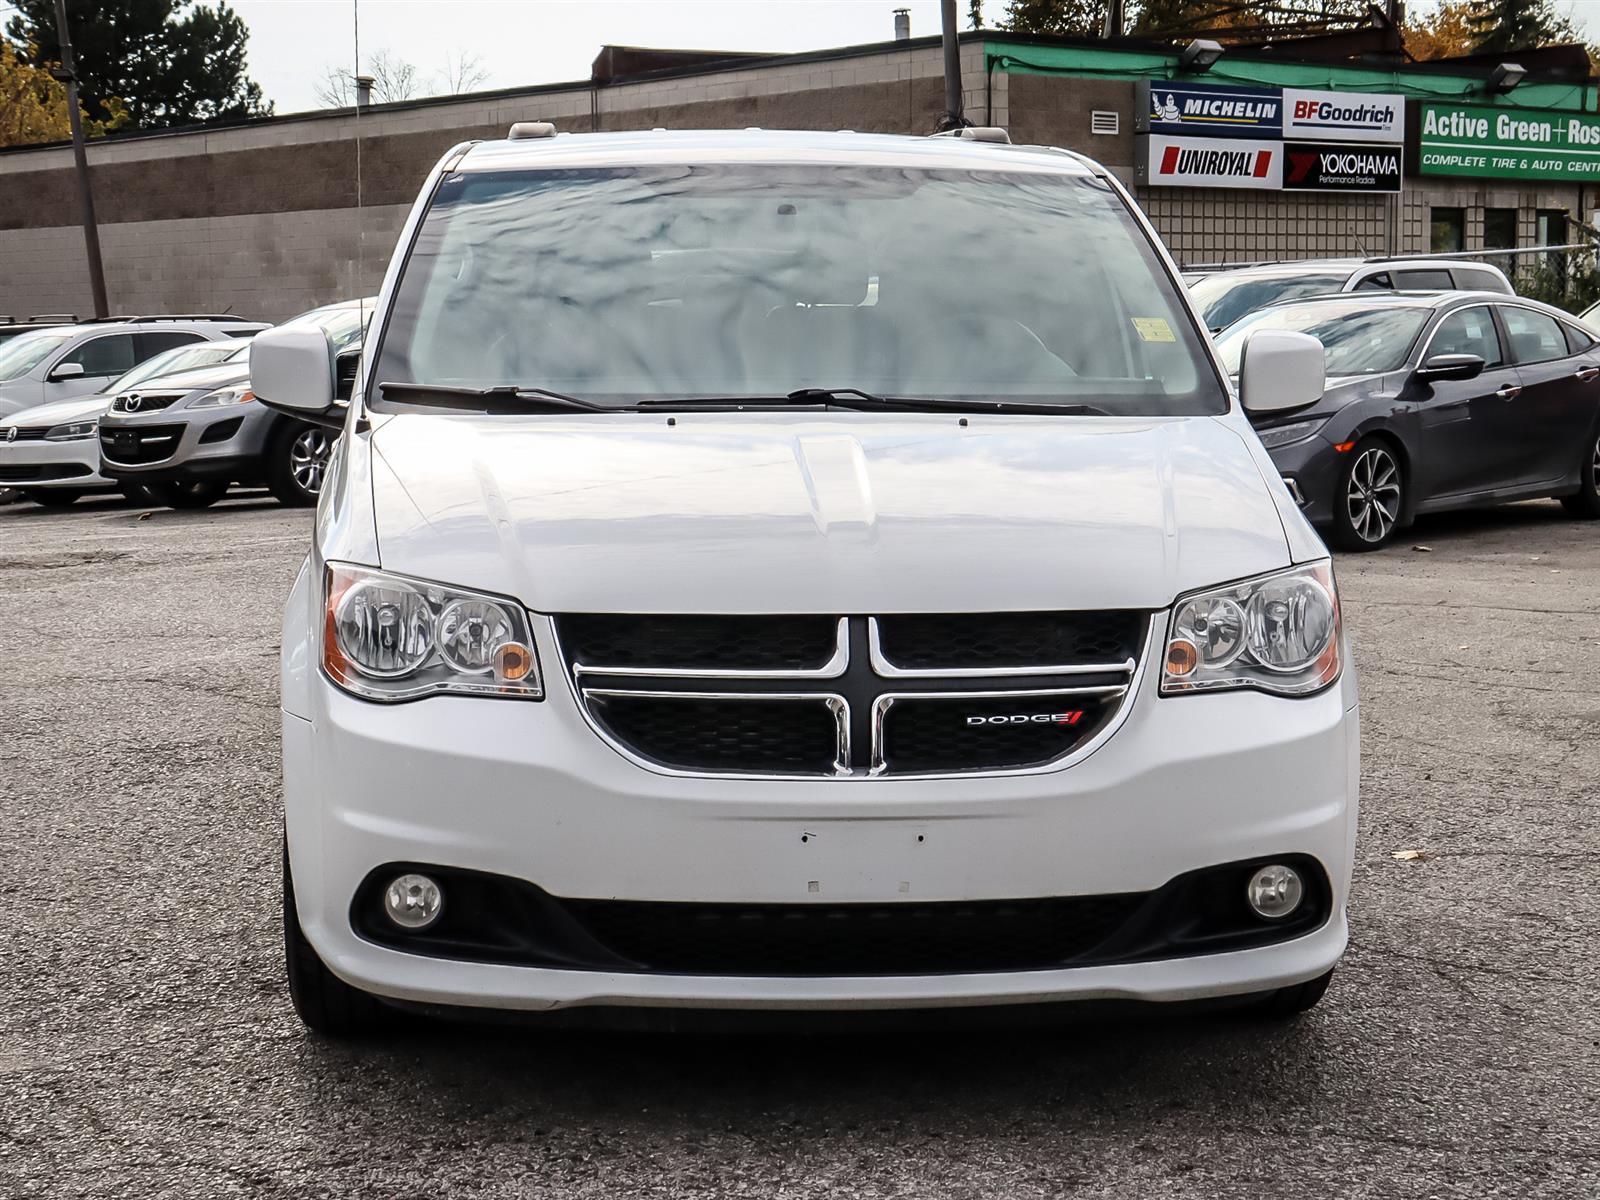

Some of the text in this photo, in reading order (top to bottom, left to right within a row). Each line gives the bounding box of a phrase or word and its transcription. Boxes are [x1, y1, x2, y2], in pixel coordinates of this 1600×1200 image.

[1184, 99, 1277, 118] MICHELIN
[1294, 101, 1394, 123] BFGoodrich
[1423, 109, 1488, 139] Active
[1178, 150, 1252, 176] UNIROYAL
[1320, 154, 1398, 175] YOKOHAMA
[1423, 154, 1487, 168] COMPLETE
[1492, 157, 1517, 169] TIRE
[1520, 159, 1528, 169] &
[1532, 160, 1563, 171] AUTO
[1319, 175, 1355, 184] Performance
[967, 713, 1069, 725] DODGE
